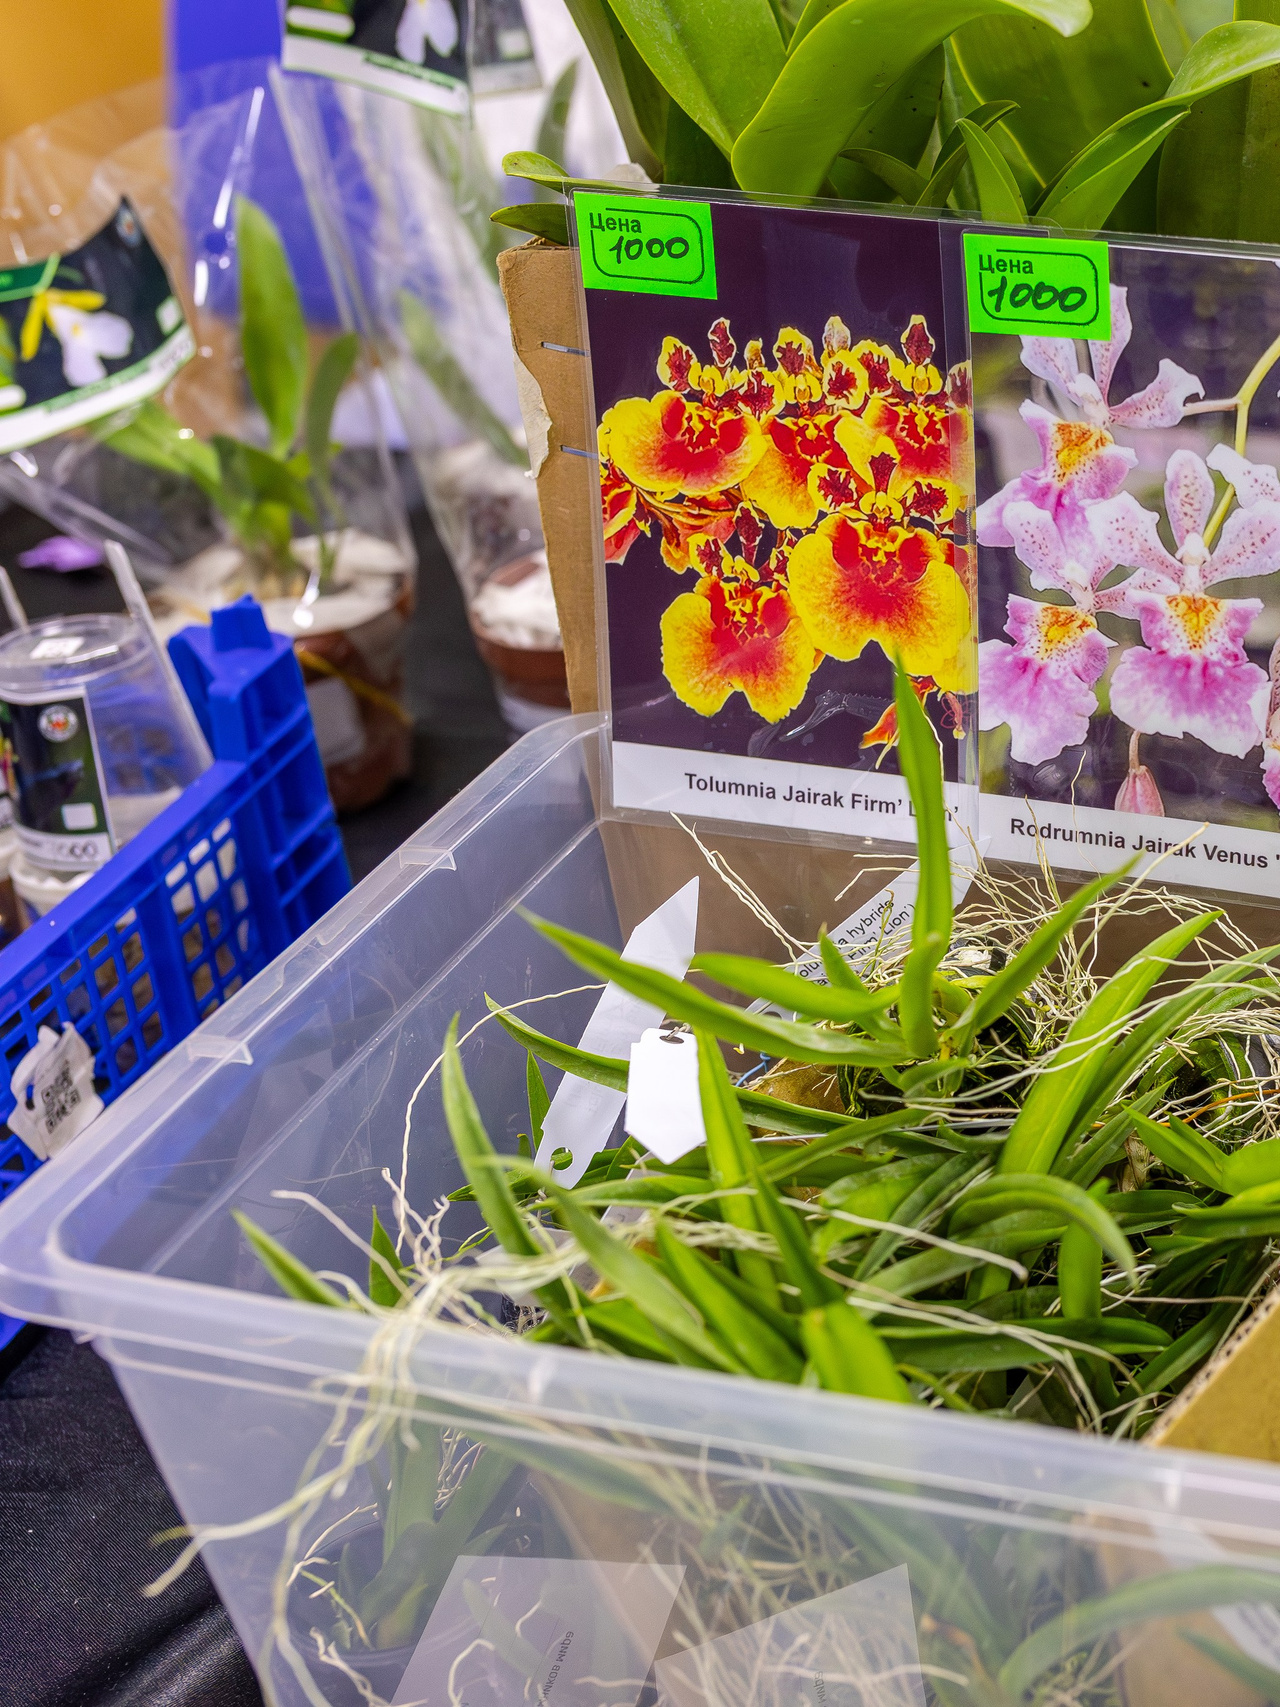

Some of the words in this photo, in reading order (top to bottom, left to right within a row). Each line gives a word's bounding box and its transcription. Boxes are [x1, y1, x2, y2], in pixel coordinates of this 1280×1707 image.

[589, 211, 641, 233] Цена
[609, 234, 690, 264] 1000
[978, 254, 1034, 275] Цена
[988, 276, 1088, 313] 1000
[684, 772, 777, 800] Tolumnia
[782, 785, 845, 808] Jairak
[1010, 818, 1126, 849] Rodrumnia
[1132, 834, 1197, 859] Jairak
[1203, 843, 1269, 869] Venus
[846, 900, 894, 938] hybrids
